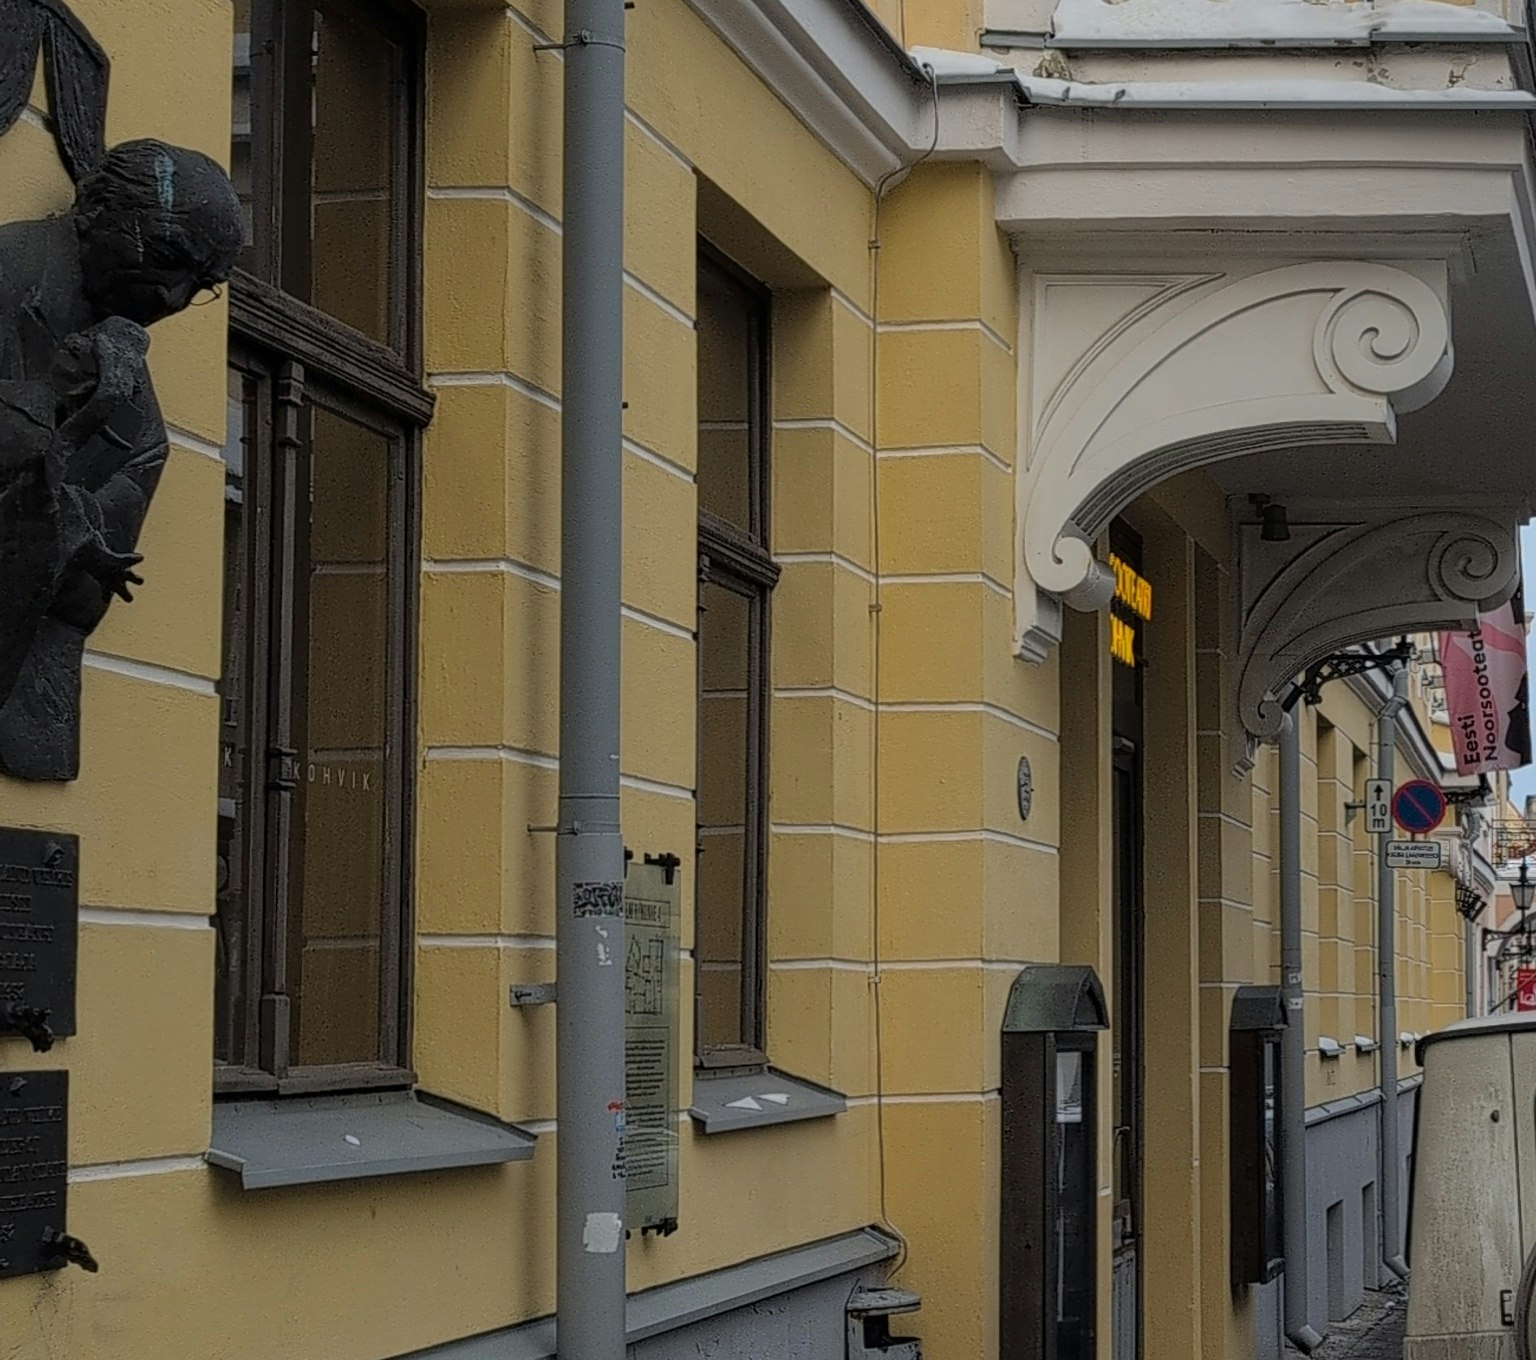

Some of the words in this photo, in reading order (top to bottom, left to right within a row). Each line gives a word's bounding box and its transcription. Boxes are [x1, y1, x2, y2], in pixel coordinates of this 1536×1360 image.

[1468, 628, 1498, 761] Noorsooteat
[1457, 713, 1481, 765] Eesti
[292, 761, 370, 791] KOHVIK
[1370, 803, 1387, 817] 10
[1372, 818, 1385, 828] m
